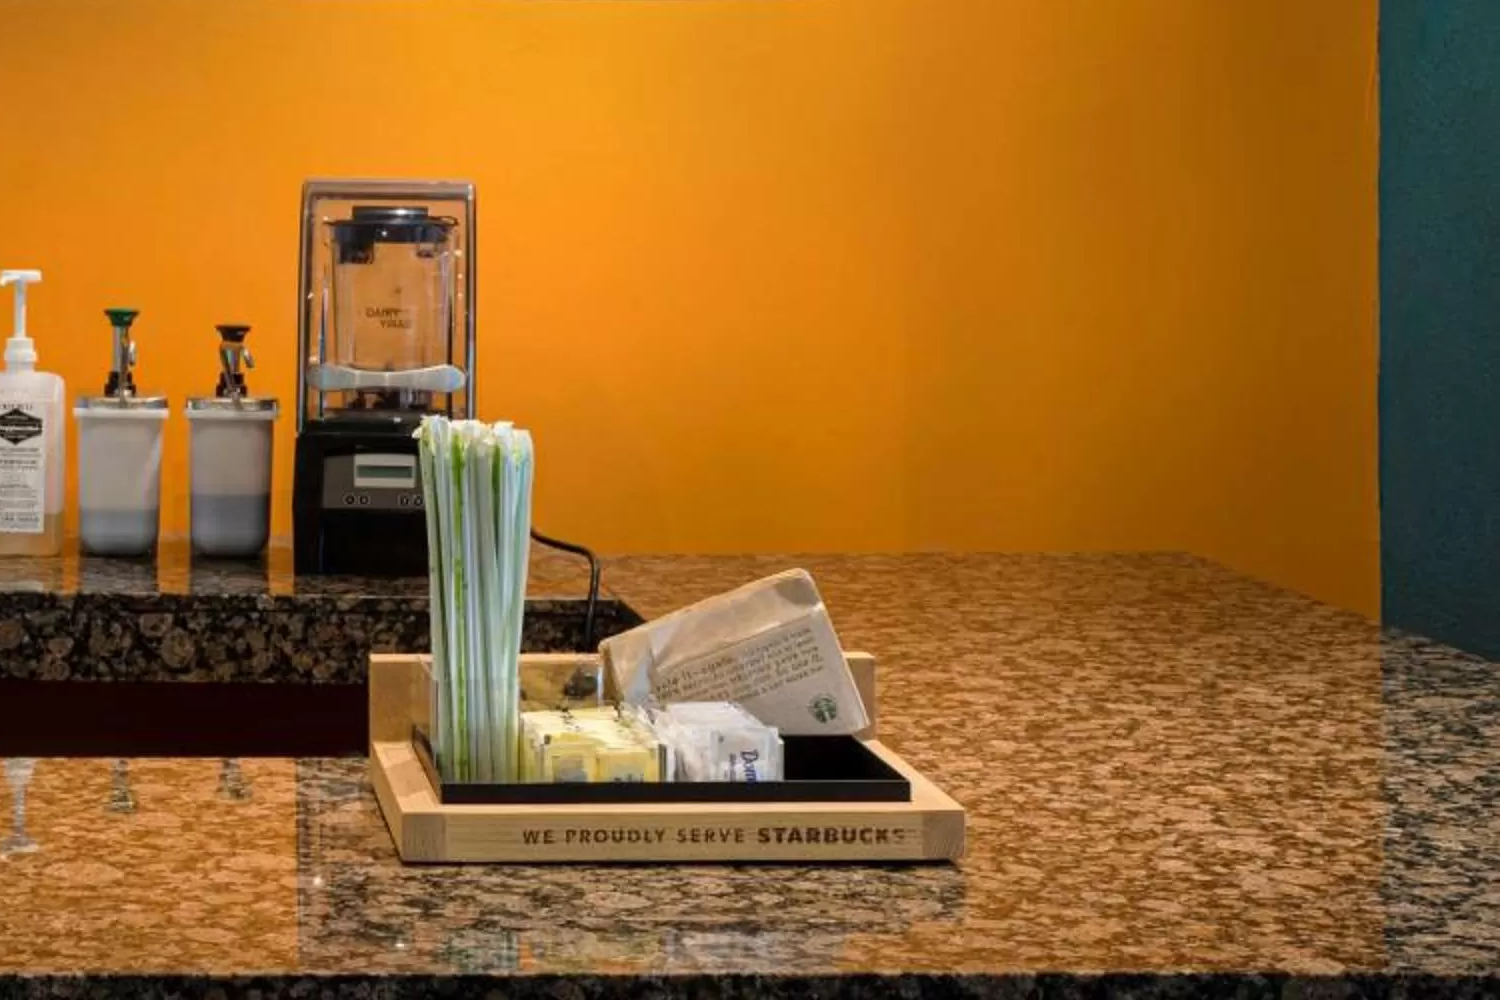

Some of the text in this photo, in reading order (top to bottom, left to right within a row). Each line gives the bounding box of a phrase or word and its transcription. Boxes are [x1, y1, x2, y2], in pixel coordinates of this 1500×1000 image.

[522, 828, 554, 845] WE
[565, 828, 666, 845] PROUDLY
[677, 828, 745, 845] SERVE
